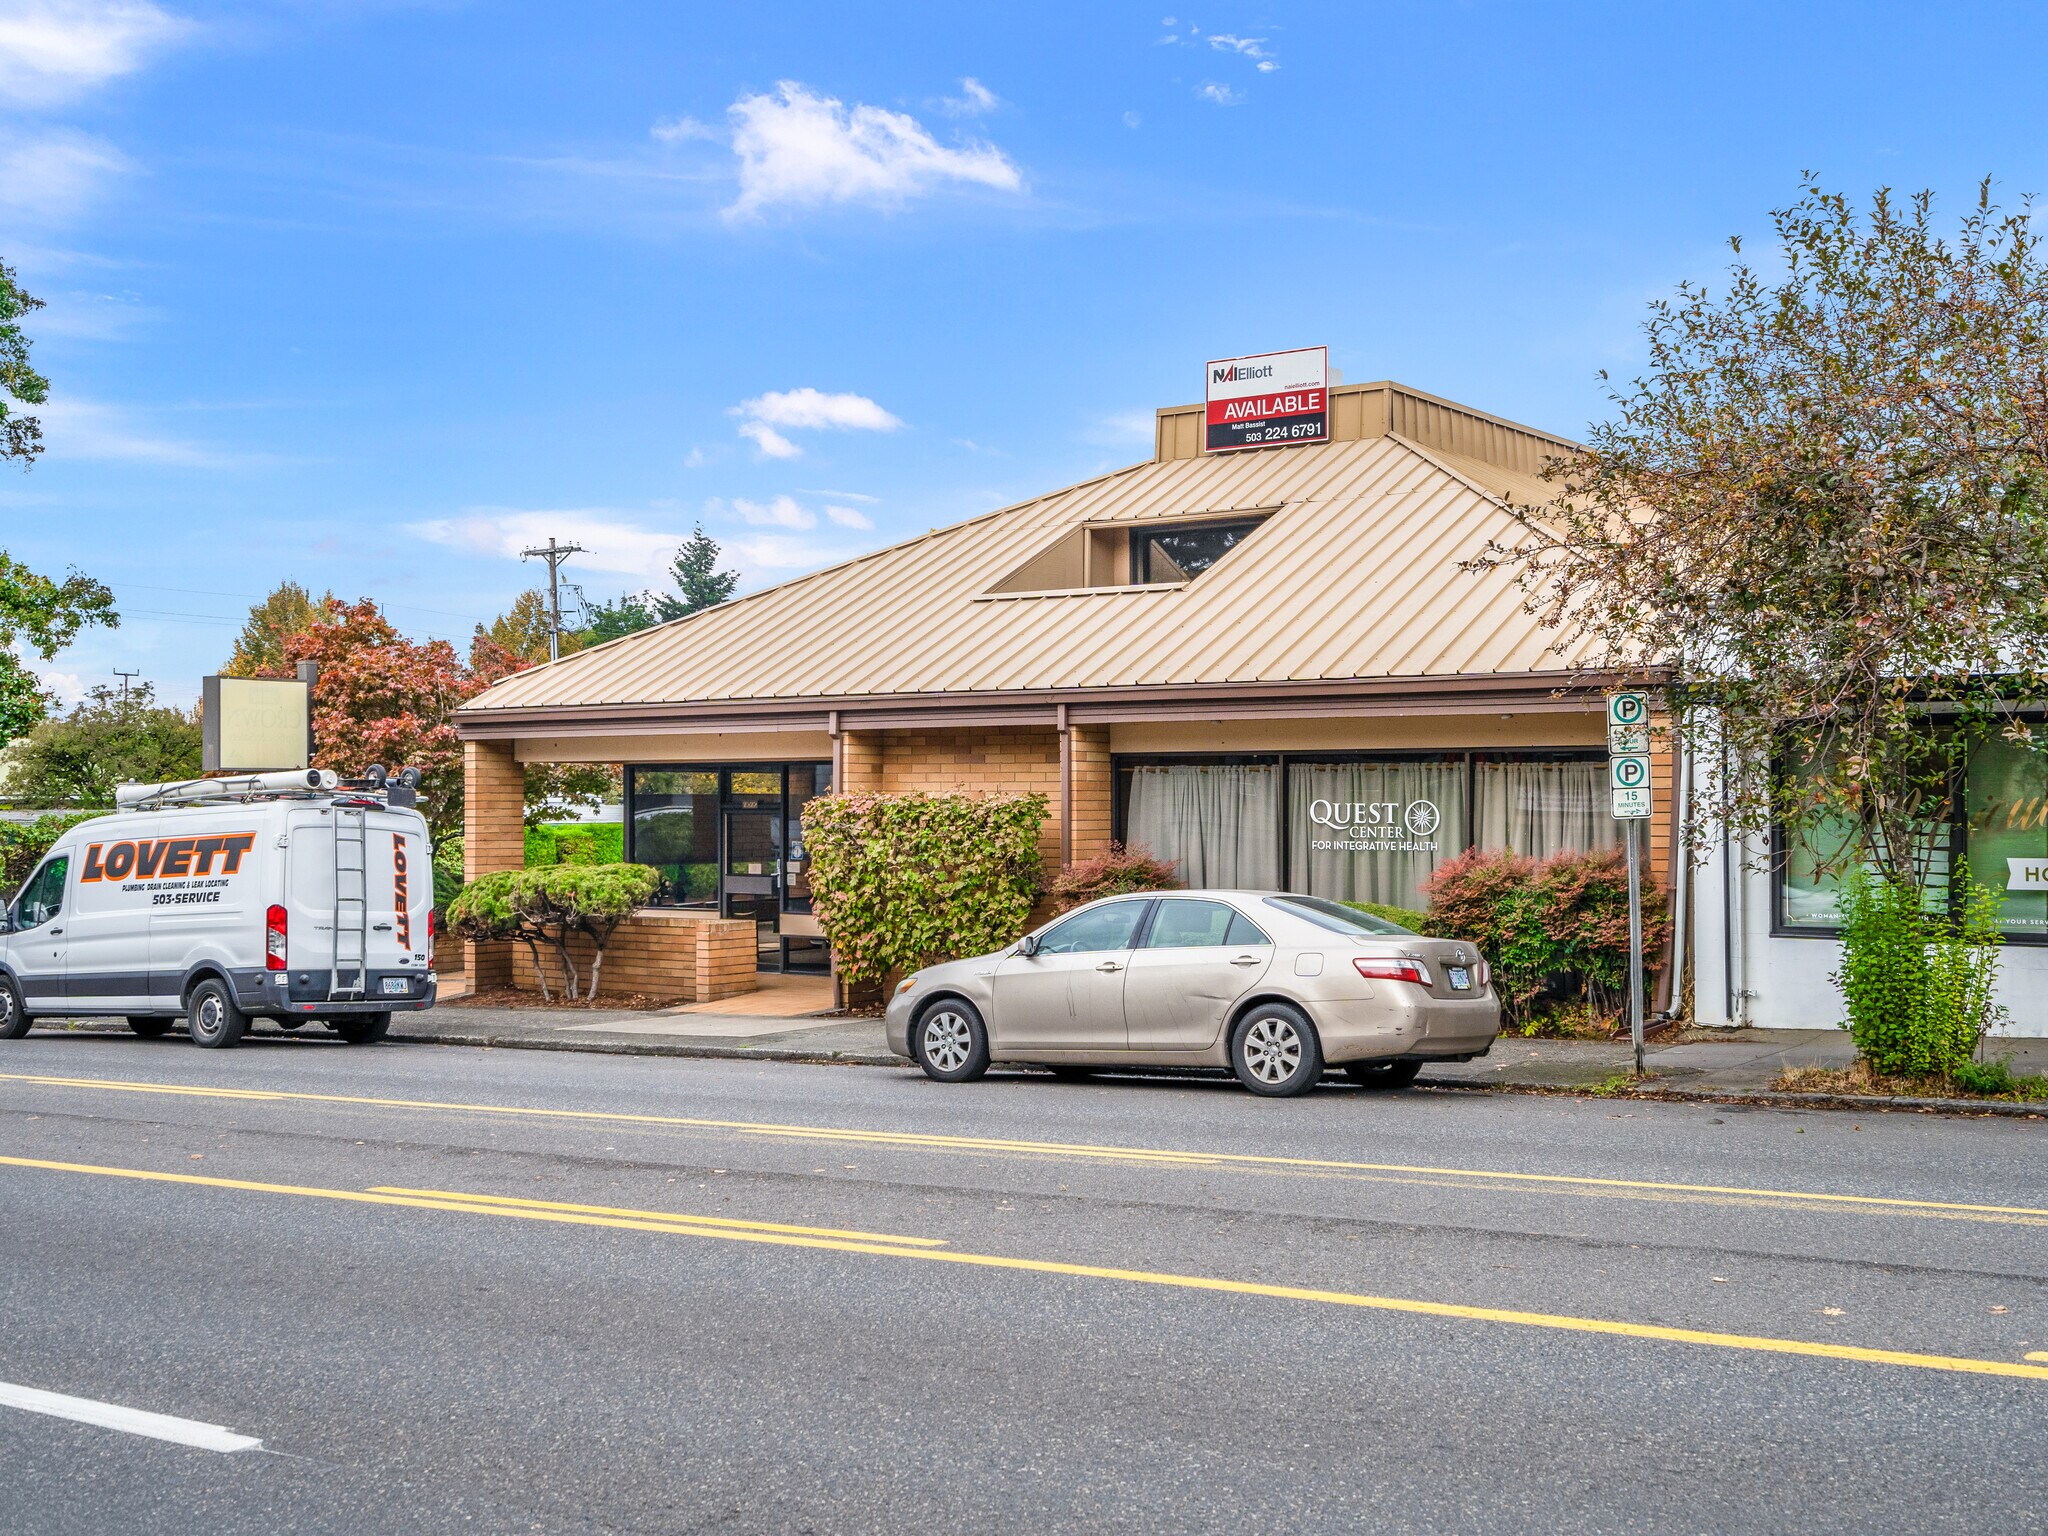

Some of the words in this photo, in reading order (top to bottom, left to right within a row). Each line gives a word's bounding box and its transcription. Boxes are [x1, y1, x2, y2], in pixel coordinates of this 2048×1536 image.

[1284, 381, 1320, 390] naielliott.com
[1224, 392, 1320, 420] AVAILABLE
[1246, 432, 1262, 442] 503
[1265, 426, 1288, 440] 224
[1291, 422, 1321, 437] 6791
[1623, 701, 1636, 717] P
[1625, 765, 1638, 781] P
[1625, 791, 1638, 801] 15
[1309, 799, 1399, 830] QUEST
[1349, 826, 1405, 839] CENTER
[1312, 841, 1332, 850] FOR
[1333, 841, 1397, 851] INTEGRATIVE
[1399, 842, 1438, 851] HEALTH
[80, 832, 256, 883] LOVETT
[122, 884, 145, 892] PLUMBING
[146, 882, 162, 890] DRAIN
[162, 881, 185, 890] CLEANING
[191, 881, 204, 889] LEAK
[205, 879, 229, 888] LOCATING
[392, 832, 411, 951] LOVETT
[152, 892, 220, 905] 503-SERVICE
